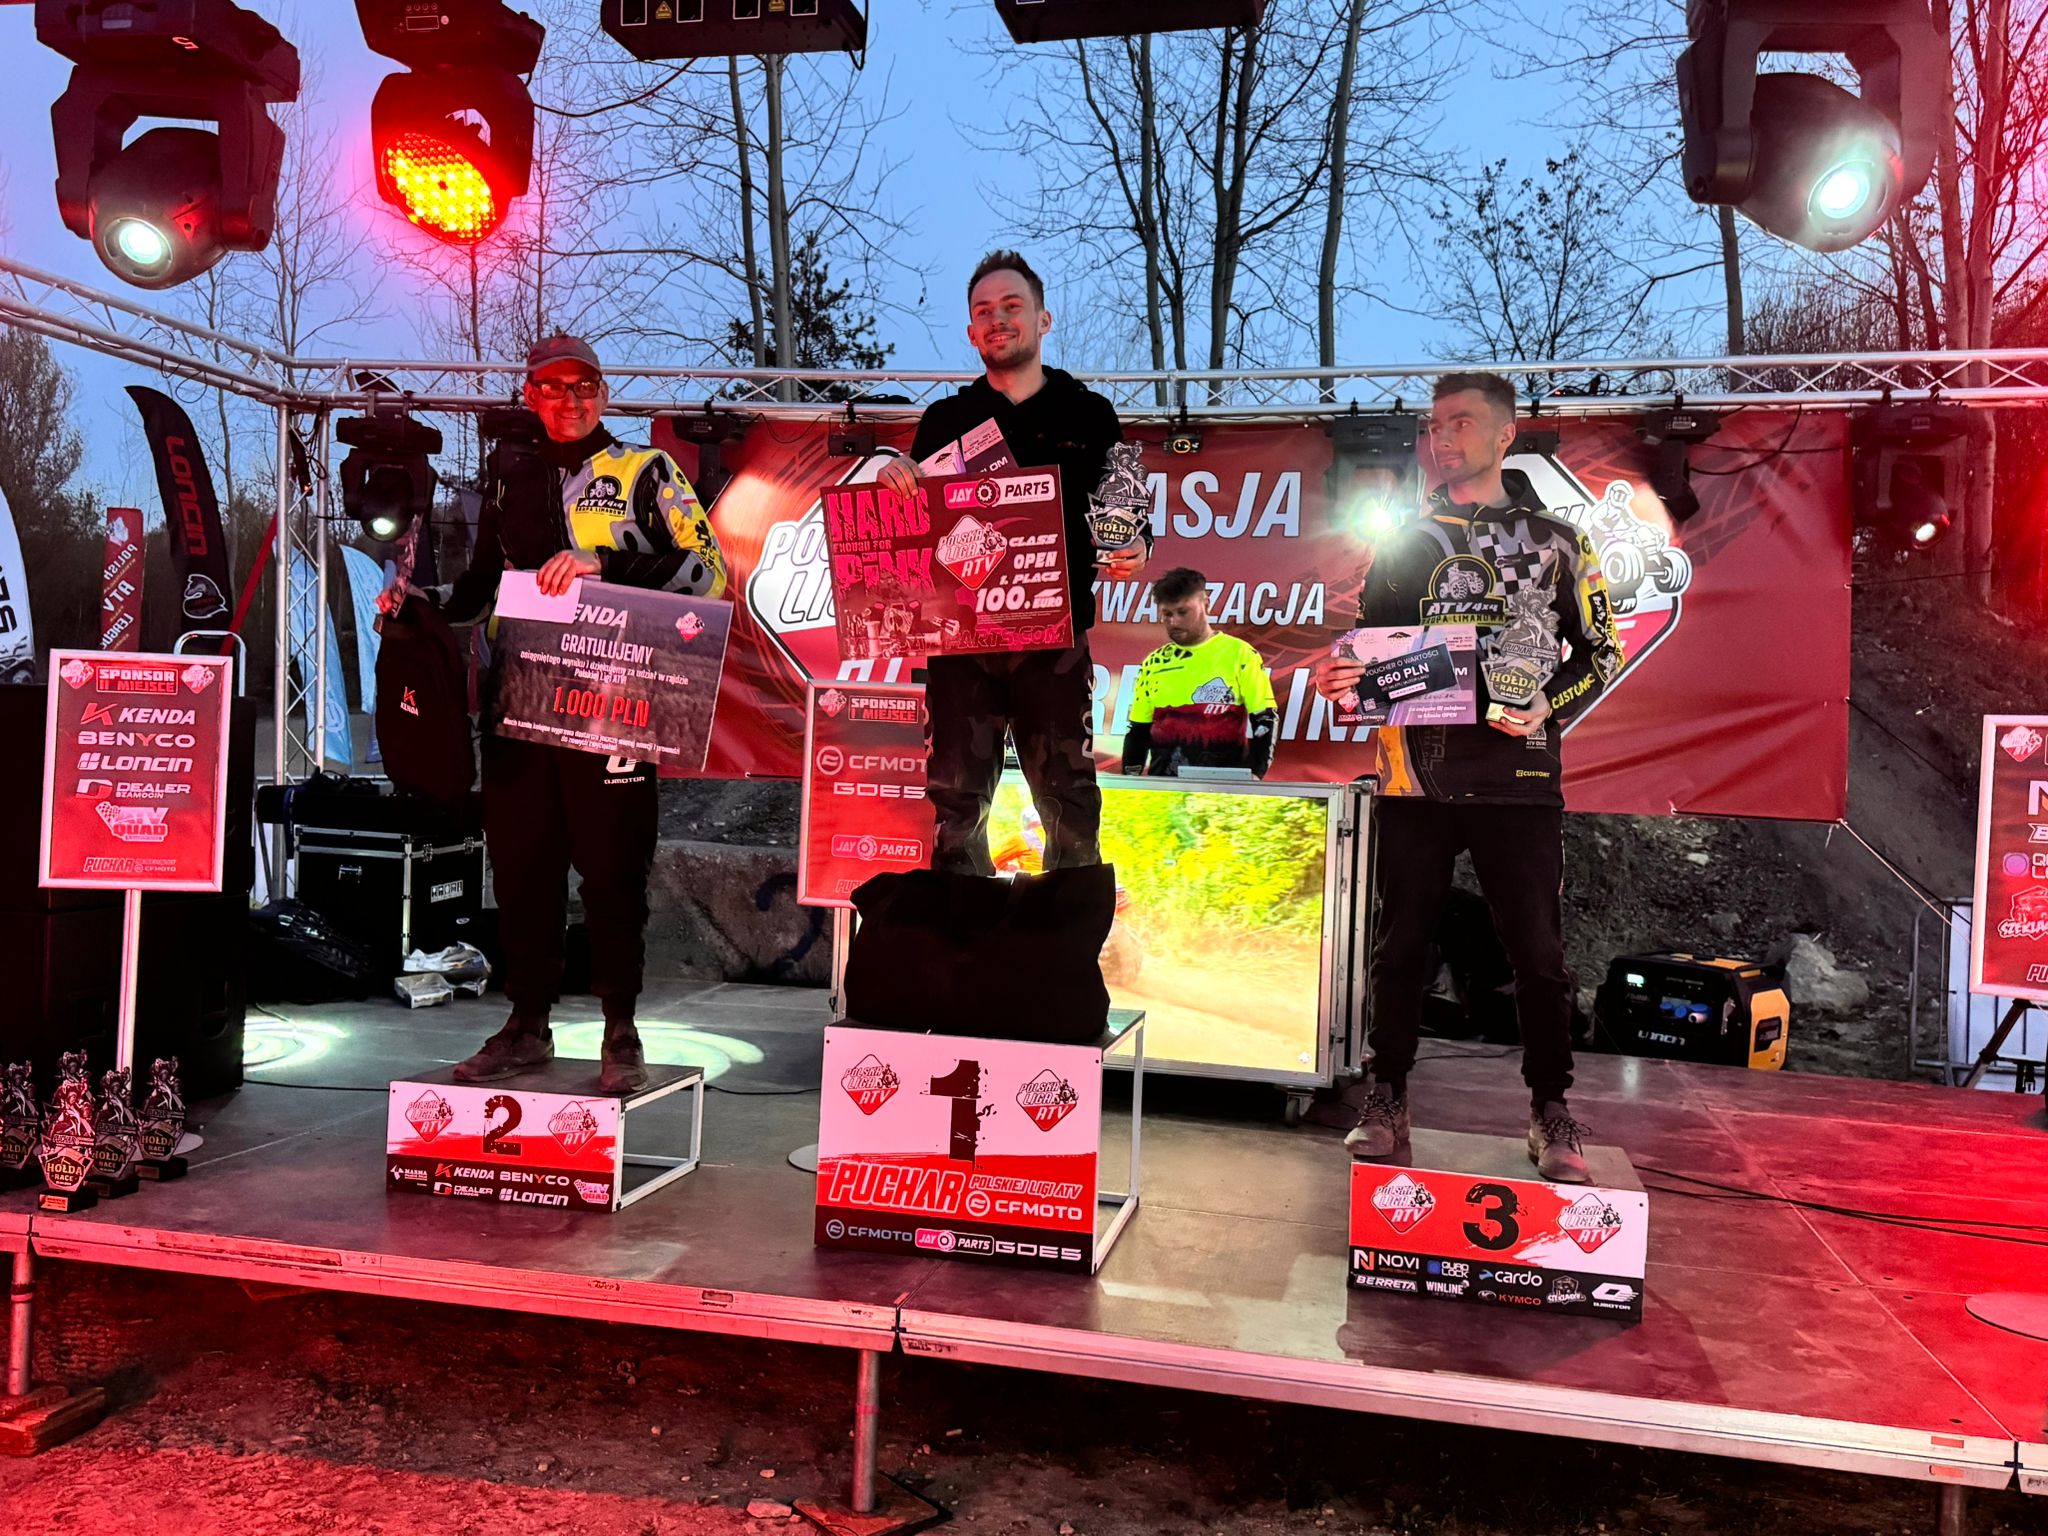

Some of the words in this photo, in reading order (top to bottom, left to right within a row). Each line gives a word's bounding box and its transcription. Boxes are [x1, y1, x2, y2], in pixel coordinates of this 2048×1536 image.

[165, 435, 208, 556] LONCIN
[949, 488, 973, 503] JAY
[1004, 481, 1050, 497] PARTS
[579, 499, 607, 507] ATV
[1143, 471, 1301, 538] ASJA
[827, 486, 931, 541] HARD
[1095, 522, 1136, 536] HOŁDA
[873, 540, 892, 549] FOR
[939, 528, 984, 546] POLSKA
[1009, 534, 1058, 547] CLASS
[1103, 533, 1125, 541] RACE
[962, 555, 997, 577] ATV
[1014, 551, 1058, 569] OPEN
[1012, 571, 1061, 585] PLACE
[976, 586, 1031, 612] 100.
[1032, 596, 1063, 609] EURO
[575, 604, 629, 629] ENDA
[1427, 602, 1472, 616] ATV
[1472, 602, 1498, 612] 4x4
[561, 633, 654, 665] GRATULUJEMY
[1504, 643, 1532, 655] PUCHAR
[1364, 662, 1397, 677] VOUCHER
[1403, 649, 1439, 665] WARTOŚCI
[99, 668, 175, 682] SPONSOR
[1376, 672, 1401, 687] 660
[1404, 663, 1430, 678] PLN
[1491, 671, 1537, 690] HOŁDA
[117, 681, 175, 693] MIEJSCE
[1500, 685, 1524, 695] RACE
[553, 686, 608, 720] 1.000
[610, 695, 650, 728] PLN
[851, 698, 916, 711] SPONSOR
[1204, 704, 1230, 714] ATV
[118, 708, 196, 725] KENDA
[863, 709, 916, 721] MIEJSCE
[78, 731, 196, 748] BENYCO
[101, 755, 193, 772] LONCIN
[849, 755, 927, 773] CFMOT
[116, 782, 191, 794] DEALER
[833, 782, 926, 799] GOES
[113, 824, 168, 836] QUAD
[836, 841, 857, 852] JAY
[879, 844, 919, 857] PARTS
[83, 857, 134, 873] PUCHAR
[835, 879, 864, 893] PUC
[844, 1066, 883, 1079] POLSKA
[1019, 1082, 1060, 1095] POLSKA
[860, 1090, 891, 1105] ATV
[920, 1059, 982, 1170] 1
[1035, 1106, 1069, 1121] ATV
[420, 1120, 447, 1133] ATV
[483, 1095, 522, 1157] 2
[141, 1135, 174, 1146] HOŁDA
[563, 1133, 591, 1145] ATV
[1, 1143, 27, 1154] OŁDA
[47, 1162, 83, 1176] HOŁDA
[454, 1167, 495, 1180] KENDA
[54, 1174, 75, 1182] RACE
[500, 1171, 570, 1186] BENYCO
[454, 1185, 493, 1194] DEALER
[829, 1160, 966, 1214] PUCHAR
[969, 1174, 1029, 1194] POLSKIEJ
[1027, 1180, 1056, 1198] LIGI
[1053, 1183, 1083, 1200] ATV
[513, 1190, 569, 1206] LONCIN
[995, 1199, 1083, 1220] CFMOTO
[1391, 1208, 1425, 1222] ATV
[1463, 1182, 1519, 1251] 3
[848, 1226, 912, 1241] CFMOTO
[1577, 1229, 1612, 1243] ATV
[918, 1233, 938, 1245] JAY
[957, 1238, 991, 1251] PARTS
[995, 1240, 1082, 1261] GOES
[1378, 1253, 1419, 1270] NOVI
[1441, 1261, 1470, 1272] QUAD
[1441, 1269, 1469, 1279] LOCK
[1495, 1271, 1543, 1287] cardo
[1356, 1275, 1416, 1291] BERRETA
[1426, 1280, 1464, 1295] WINLINE
[1499, 1294, 1541, 1306] KYMCO
